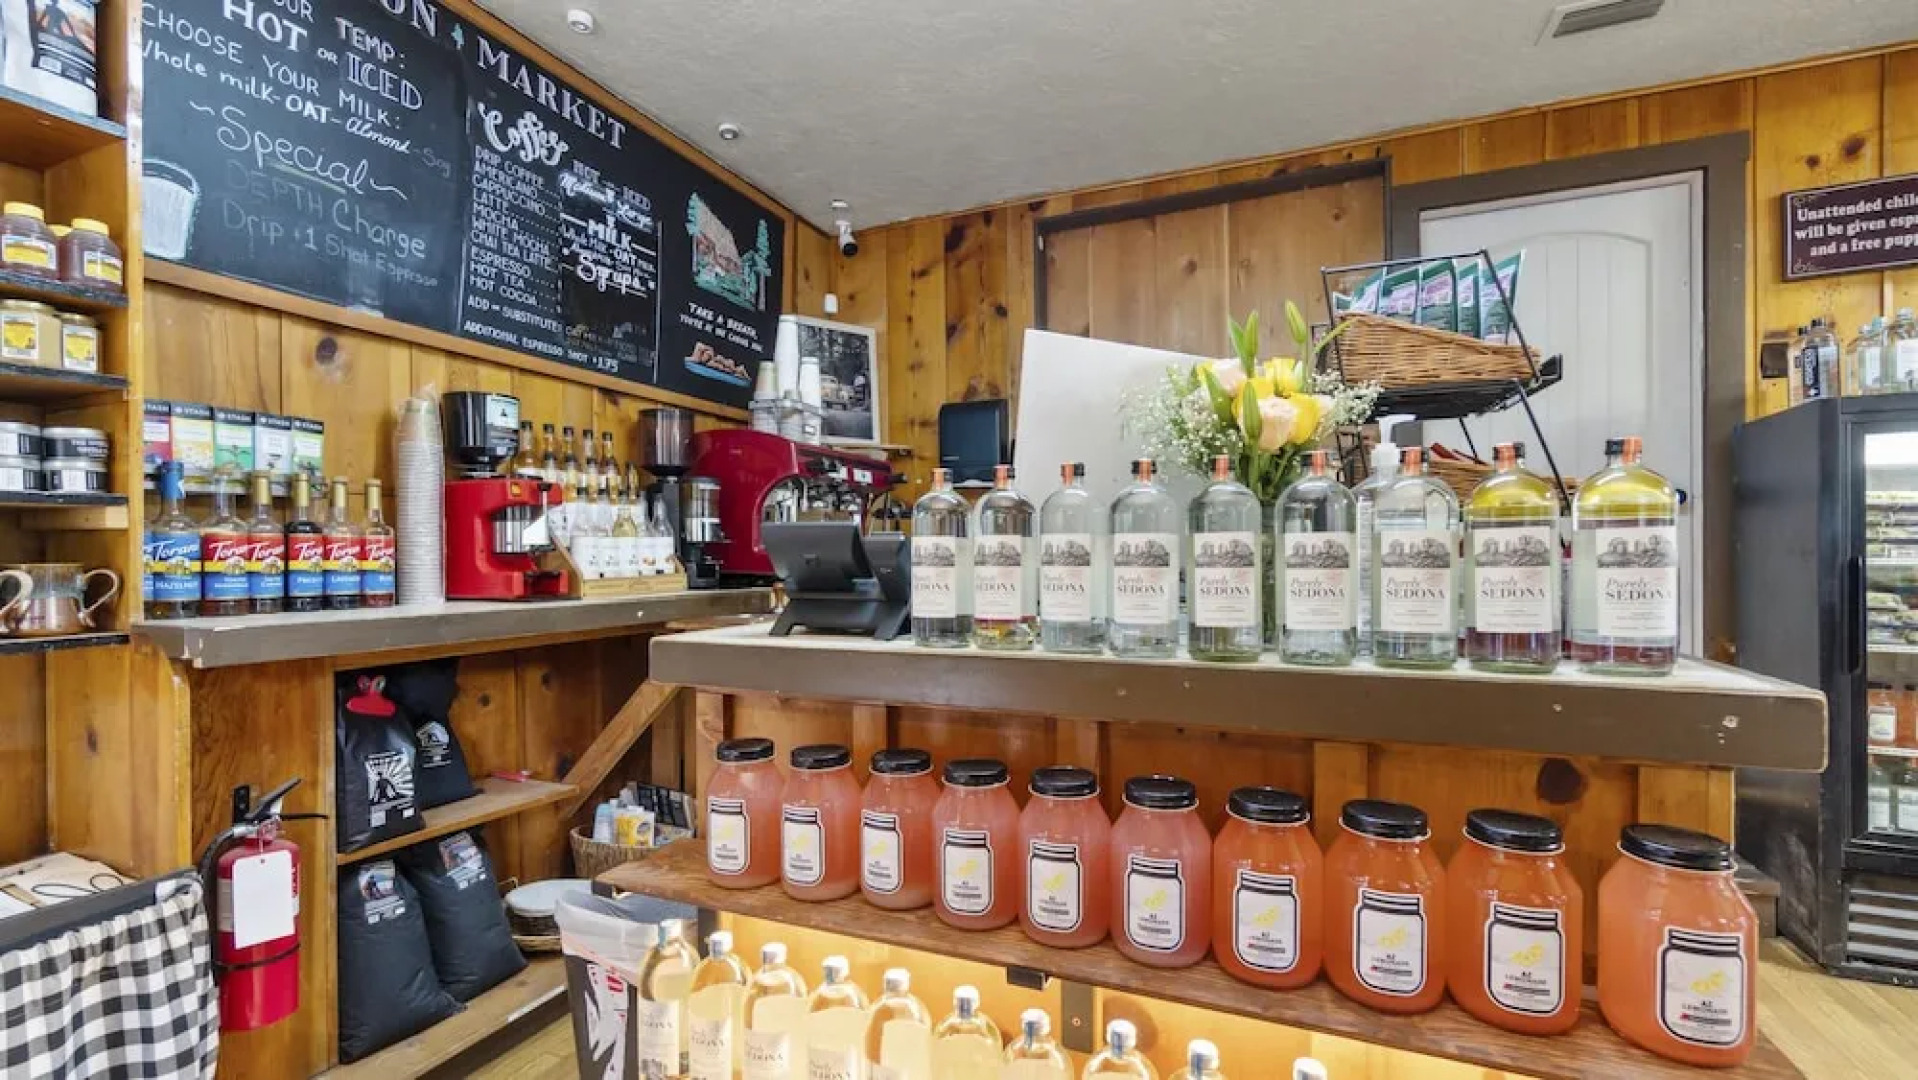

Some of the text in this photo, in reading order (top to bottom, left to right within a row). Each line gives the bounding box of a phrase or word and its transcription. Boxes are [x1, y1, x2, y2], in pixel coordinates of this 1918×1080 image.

[223, 0, 307, 51] HOT
[346, 51, 423, 110] ICED
[334, 17, 405, 69] TEMP:
[142, 2, 243, 64] CHOOSE
[262, 54, 320, 97] YOUR
[338, 89, 401, 129] MILK:
[476, 35, 626, 149] MARKET
[217, 105, 370, 194] Special
[474, 160, 537, 199] AMERICANO
[475, 145, 544, 190] DRIP COFFEE
[227, 158, 323, 218] DEPTH
[472, 174, 545, 215] CAPPUCCINO
[473, 188, 509, 214] LATTE
[473, 201, 519, 230] MOCHA
[1797, 194, 1918, 222] Unattended chil
[472, 214, 549, 256] WHITE MOCHA
[1795, 223, 1824, 240] will
[1827, 221, 1844, 236] be
[1847, 217, 1886, 239] given
[472, 229, 498, 250] CHAI
[502, 241, 520, 258] TEA
[523, 248, 551, 270] LATTE
[1810, 242, 1837, 257] and
[1840, 243, 1848, 253] a
[1851, 236, 1881, 251] free
[470, 260, 525, 289] HOT TEA
[471, 245, 531, 278] ESPRESSO
[467, 294, 490, 311] ADD
[470, 274, 538, 307] HOT COCOA
[688, 302, 714, 321] TAKE
[463, 319, 519, 346] ADDITIONAL
[521, 336, 563, 357] ESPRESSO
[567, 349, 588, 364] SHOT
[1117, 584, 1165, 595] SEDONA
[1200, 586, 1251, 597] SEDONA
[1290, 588, 1346, 600] SEDONA
[1386, 588, 1445, 600] SEDONA
[1481, 588, 1546, 600] SEDONA
[1605, 590, 1671, 602] SEDONA
[1606, 577, 1651, 591] Purely
